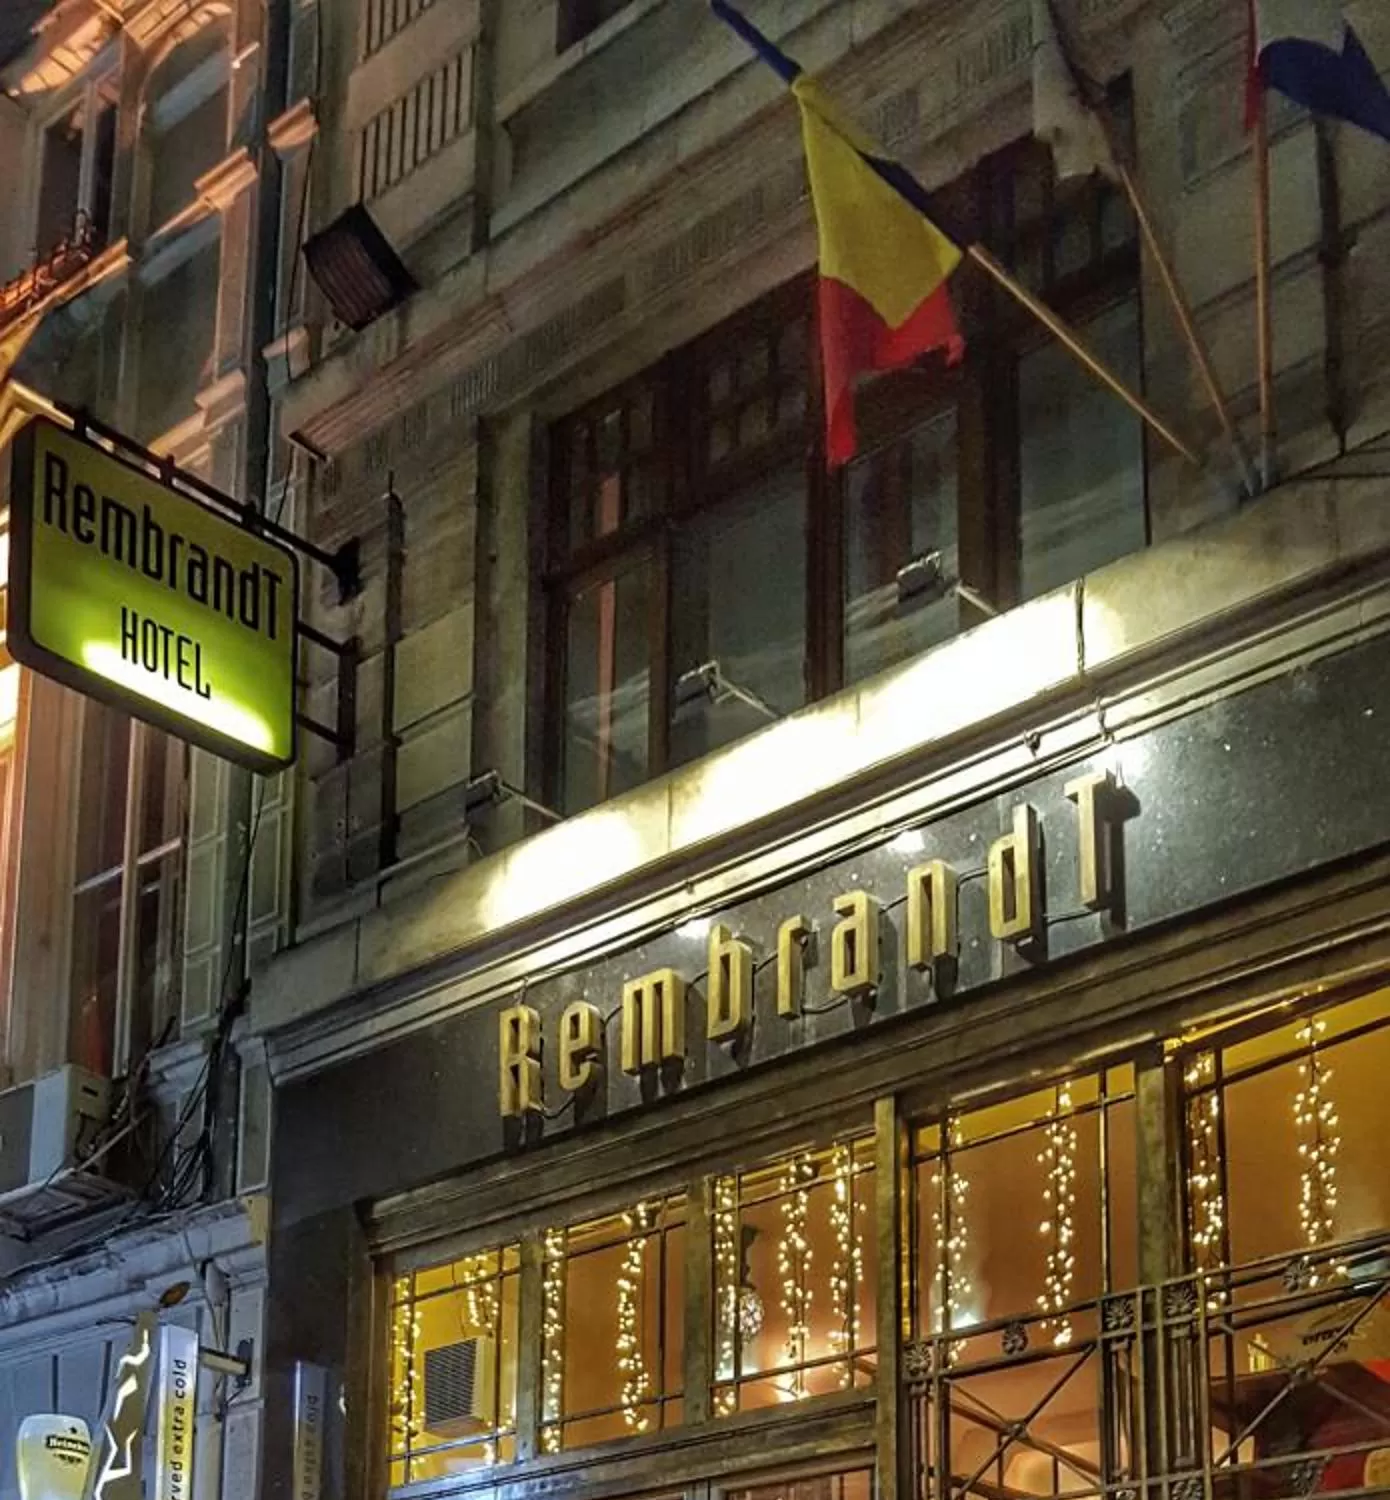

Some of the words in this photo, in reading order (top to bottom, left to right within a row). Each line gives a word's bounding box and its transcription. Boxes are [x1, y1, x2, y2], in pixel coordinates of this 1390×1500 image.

[120, 606, 212, 700] HOTEL
[173, 1359, 188, 1399] cold
[172, 1405, 186, 1456] extra
